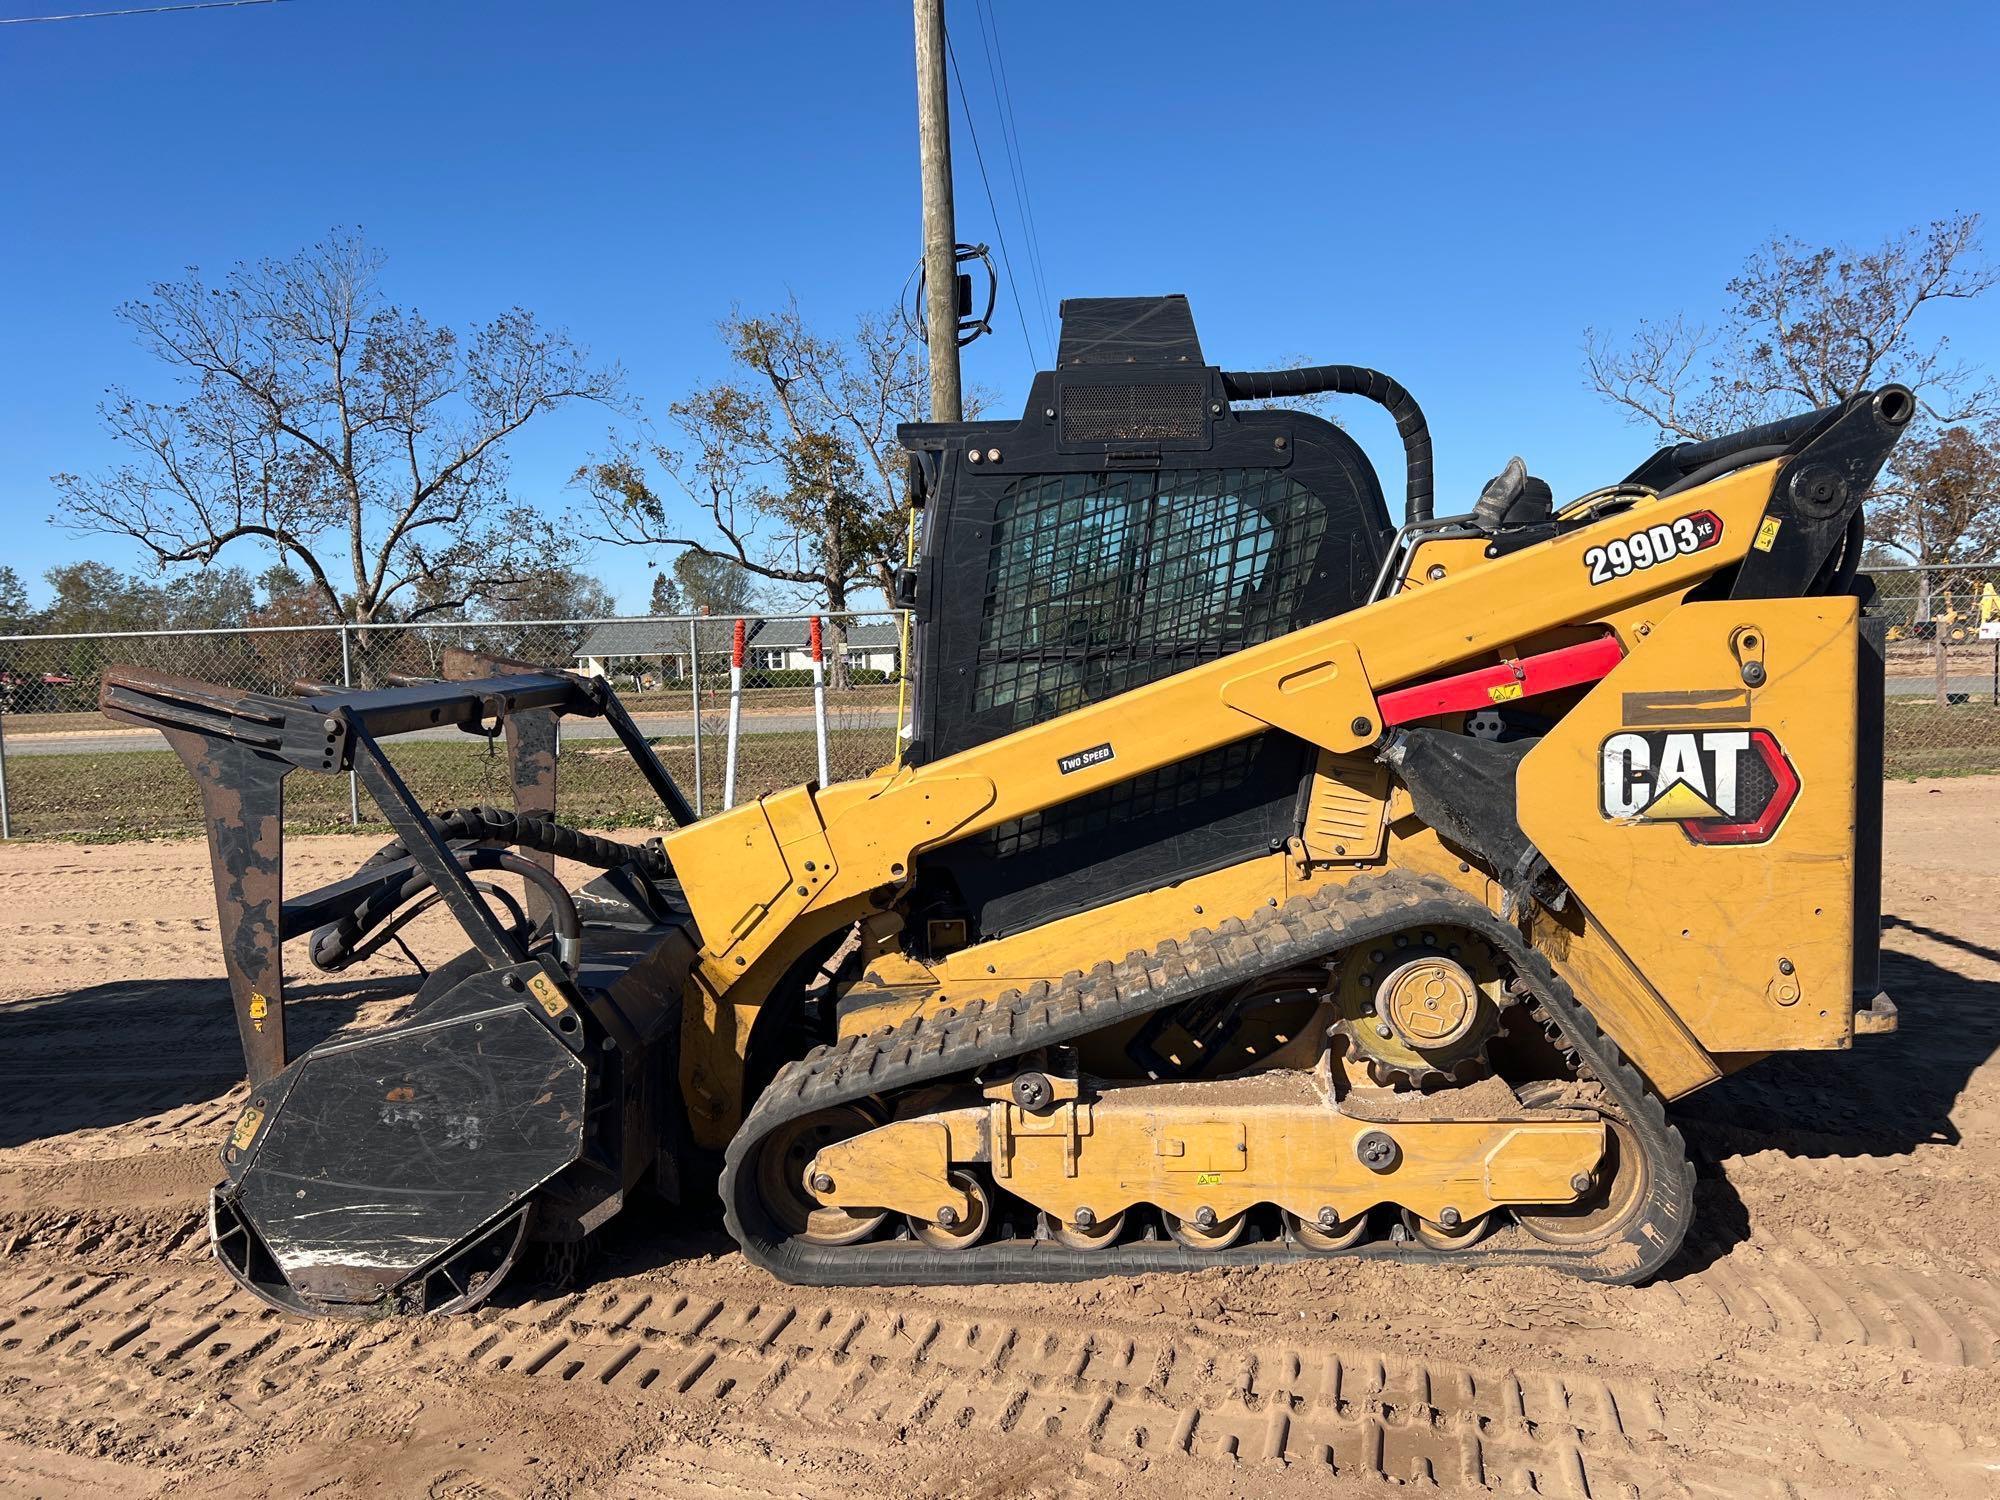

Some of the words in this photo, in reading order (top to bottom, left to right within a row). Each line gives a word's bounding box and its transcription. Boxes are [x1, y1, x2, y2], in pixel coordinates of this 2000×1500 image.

[1585, 518, 1699, 584] 299D3
[1697, 522, 1713, 537] XE
[1062, 757, 1081, 771] TWO
[1082, 748, 1109, 764] SPEED
[1603, 731, 1750, 818] CAT
